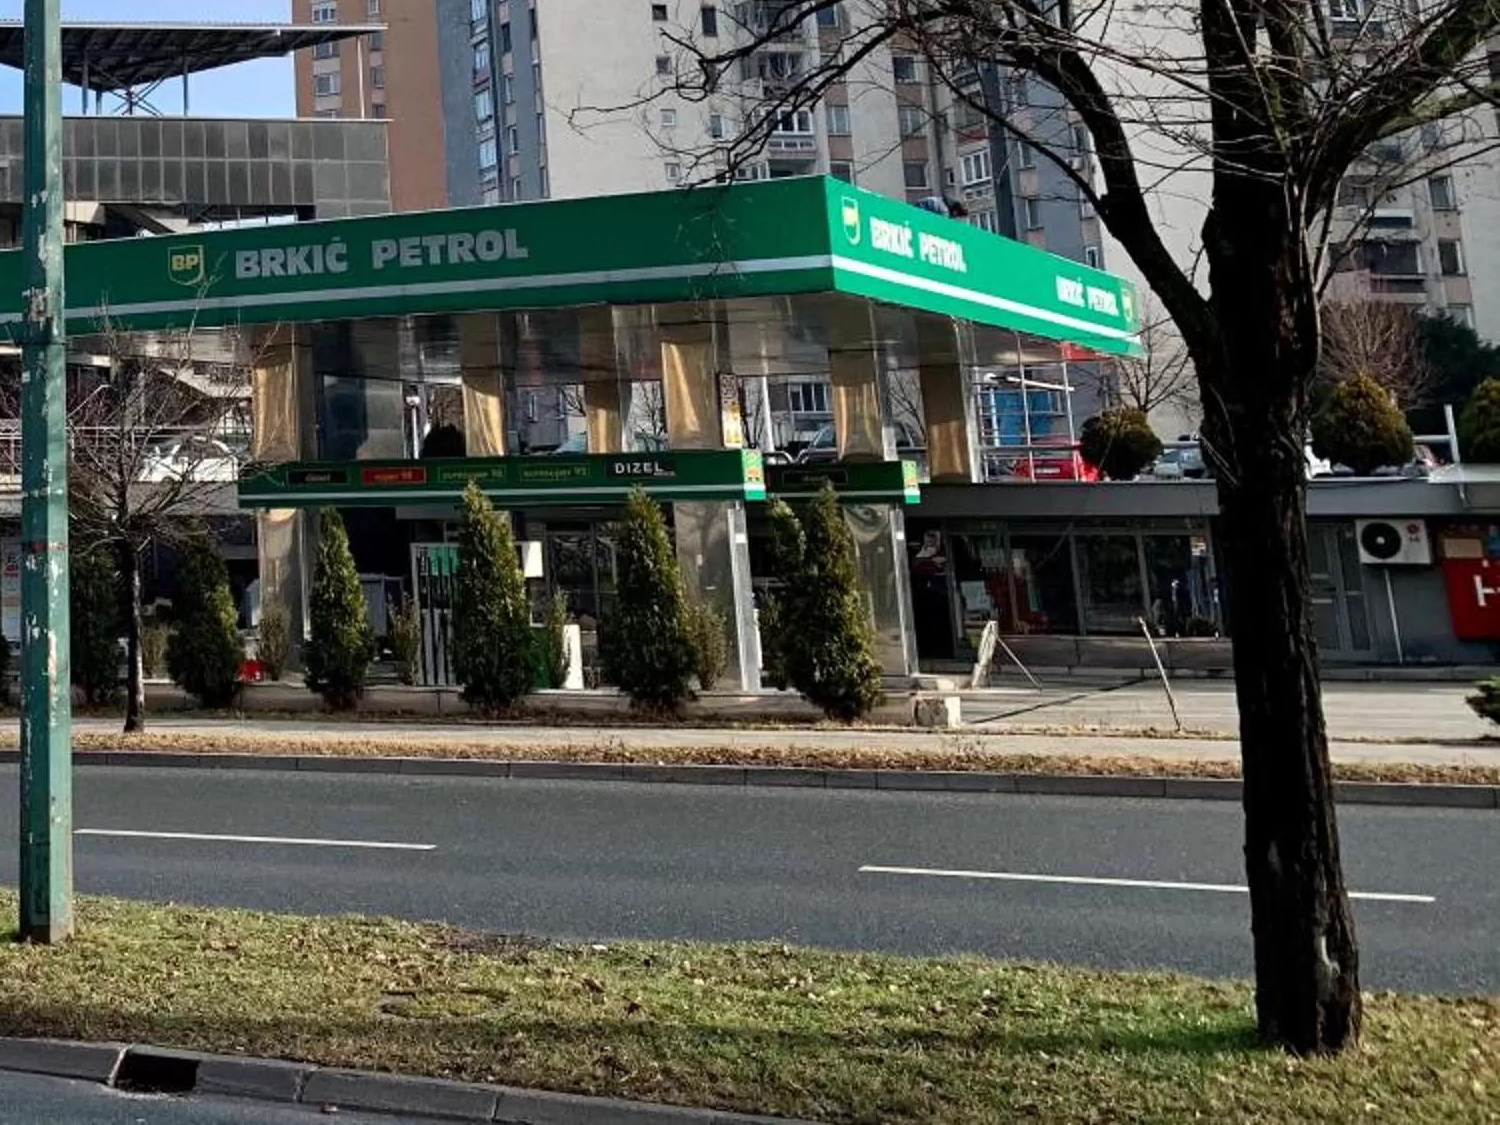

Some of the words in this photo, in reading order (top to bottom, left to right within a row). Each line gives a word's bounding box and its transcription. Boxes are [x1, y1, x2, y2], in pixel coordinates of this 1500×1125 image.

[171, 254, 200, 272] BP
[235, 236, 349, 279] BRKIĆ
[372, 228, 528, 269] PETROL
[918, 231, 967, 273] PETROL
[615, 462, 663, 474] DIZEL
